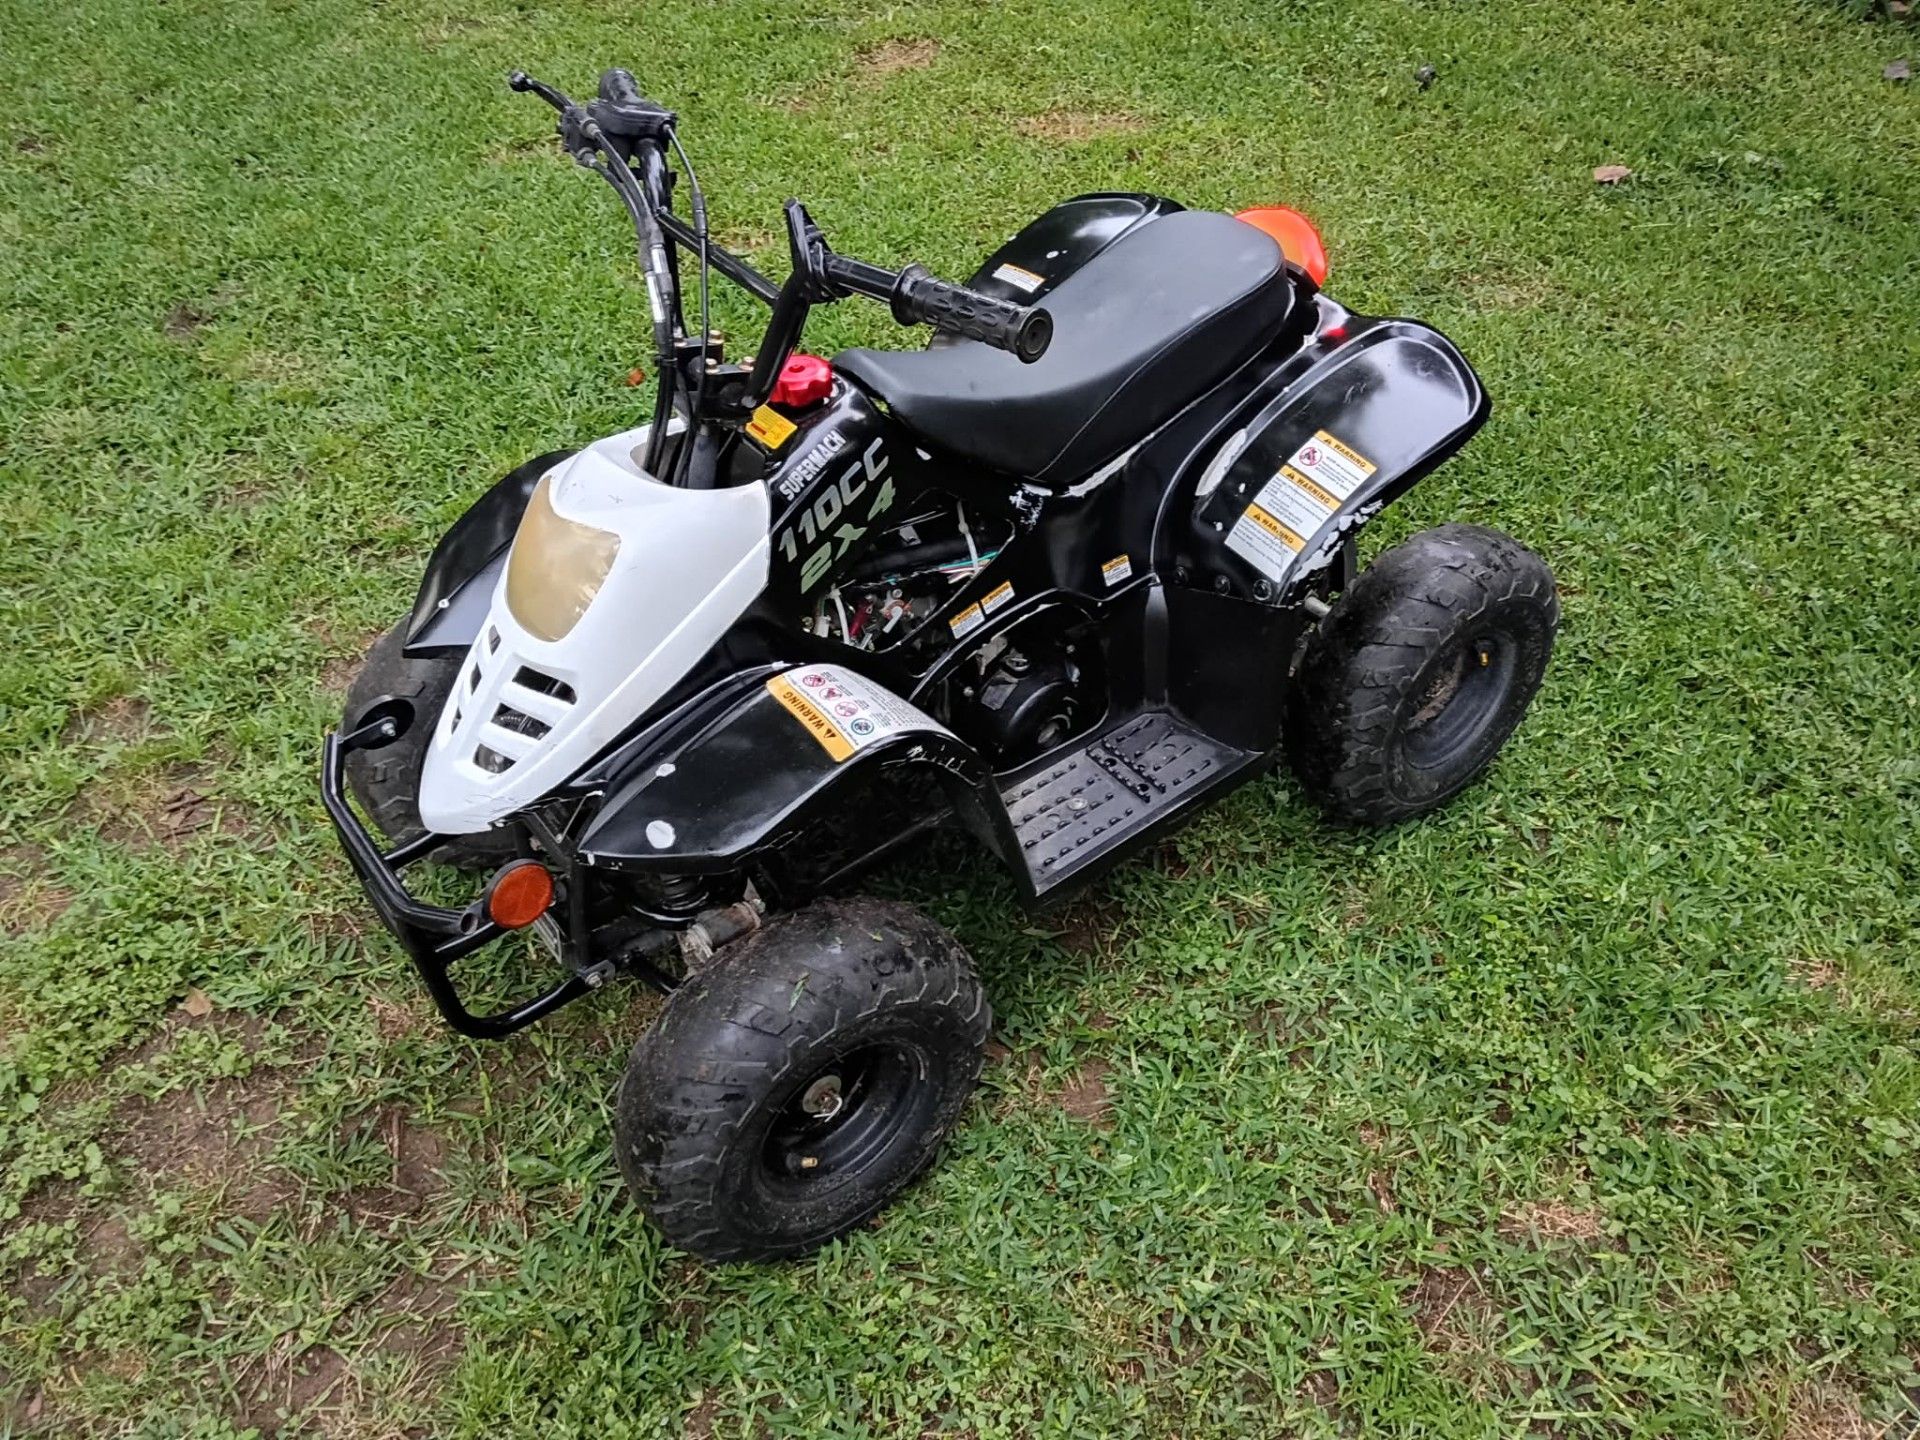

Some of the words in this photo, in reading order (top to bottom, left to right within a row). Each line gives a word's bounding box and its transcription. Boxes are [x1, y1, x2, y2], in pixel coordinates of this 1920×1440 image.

[779, 429, 847, 501] SUPERMACH
[1334, 444, 1367, 468] WARNING
[779, 437, 889, 563] 110CC
[1297, 478, 1331, 504] WARNING
[783, 691, 826, 730] WARNING
